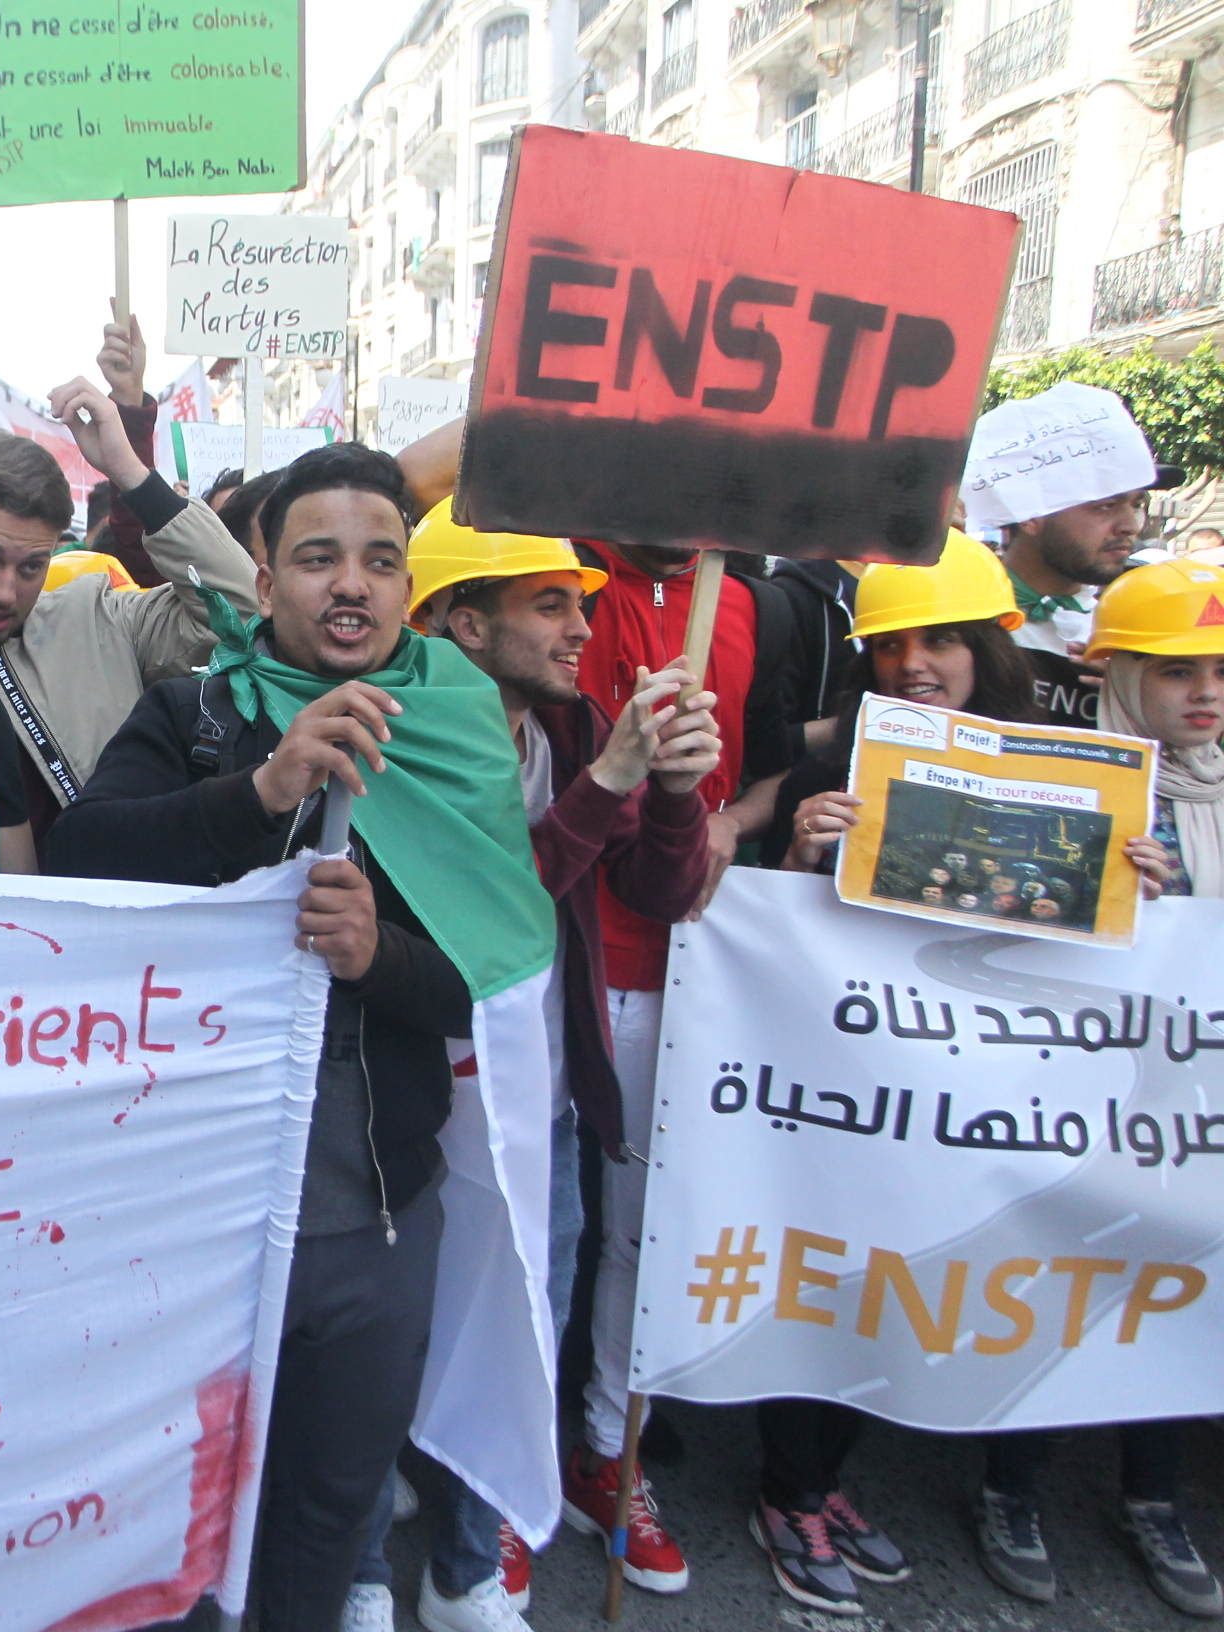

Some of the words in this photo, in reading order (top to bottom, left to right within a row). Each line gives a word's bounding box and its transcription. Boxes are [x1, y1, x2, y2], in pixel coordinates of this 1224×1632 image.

[32, 17, 60, 37] ne
[69, 18, 116, 35] cesse
[126, 2, 179, 33] d'être
[24, 64, 91, 87] cessant
[100, 61, 153, 83] d'être
[29, 122, 64, 141] une
[77, 107, 101, 137] loi
[146, 156, 194, 178] Malek
[203, 159, 229, 179] Ben
[170, 219, 199, 267] La
[222, 267, 269, 296] des
[181, 291, 300, 352] Martyrs
[266, 330, 344, 358] #ENSTP
[515, 254, 957, 441] ENSTP
[956, 728, 990, 747] Projet
[1001, 739, 1052, 752] Construction
[1053, 744, 1075, 755] d'une
[1077, 748, 1109, 760] nouvelle
[926, 766, 958, 787] Étape
[995, 787, 1027, 799] TOUT
[833, 979, 958, 1056] بناة
[974, 994, 1152, 1060] للمجد
[710, 1061, 914, 1141] الحياة
[933, 1092, 1089, 1157] منها
[687, 1225, 1207, 1356] #ENSTP
